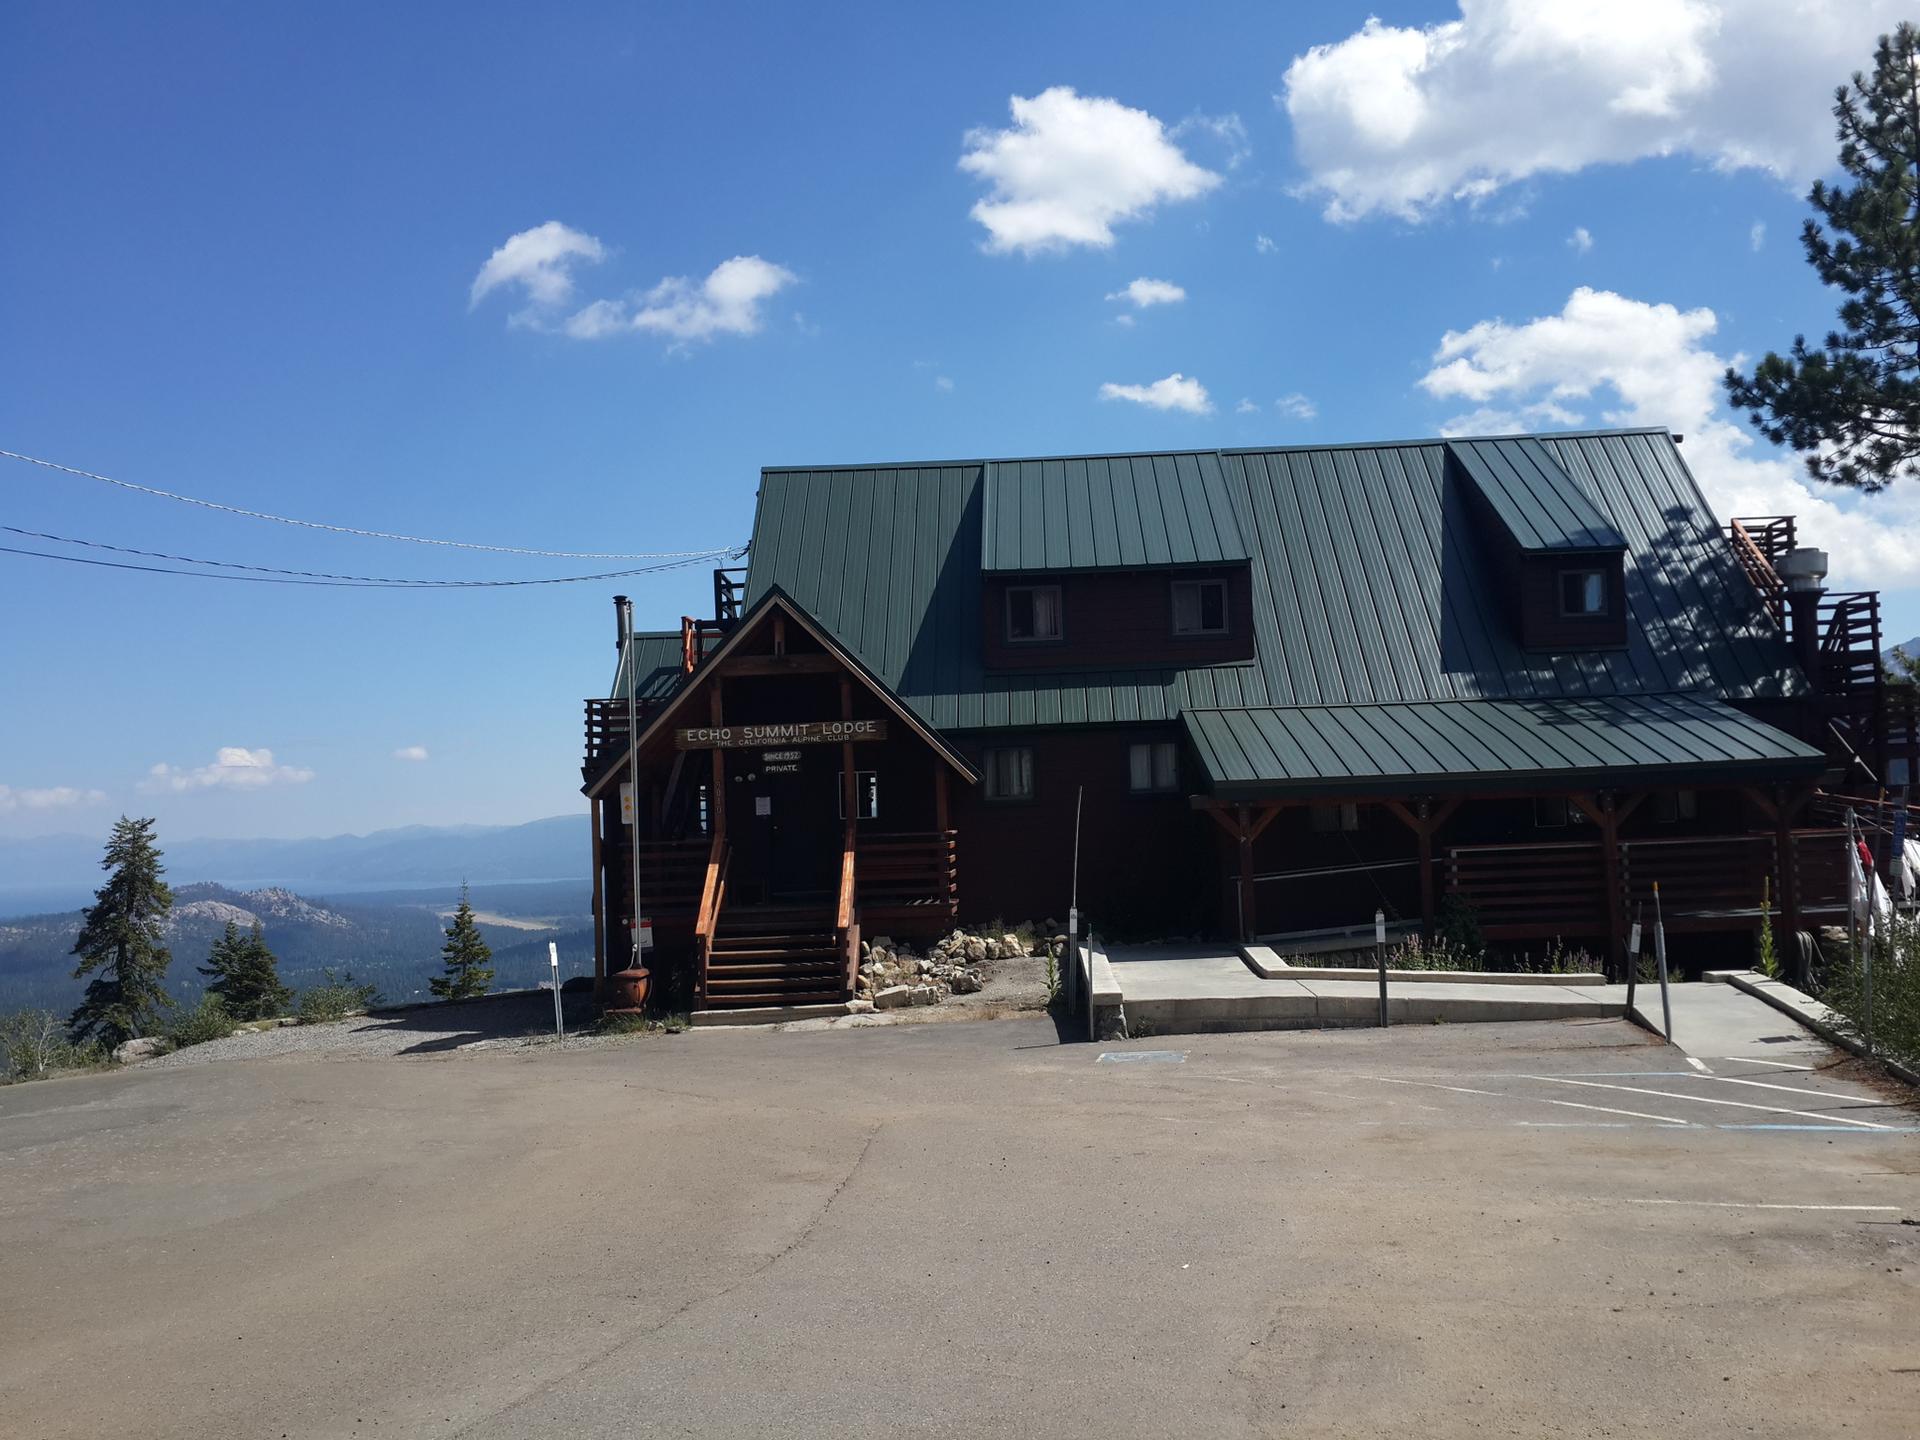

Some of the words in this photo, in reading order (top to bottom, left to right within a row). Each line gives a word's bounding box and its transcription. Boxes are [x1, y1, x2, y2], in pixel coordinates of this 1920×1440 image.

[687, 728, 731, 741] ECHO
[743, 724, 810, 739] SUMMIT
[822, 721, 877, 735] LODGE
[738, 737, 786, 746] CALIFORNIA
[792, 735, 821, 743] ALPINE
[763, 752, 783, 760] SINCE
[765, 764, 798, 772] PRIVATE
